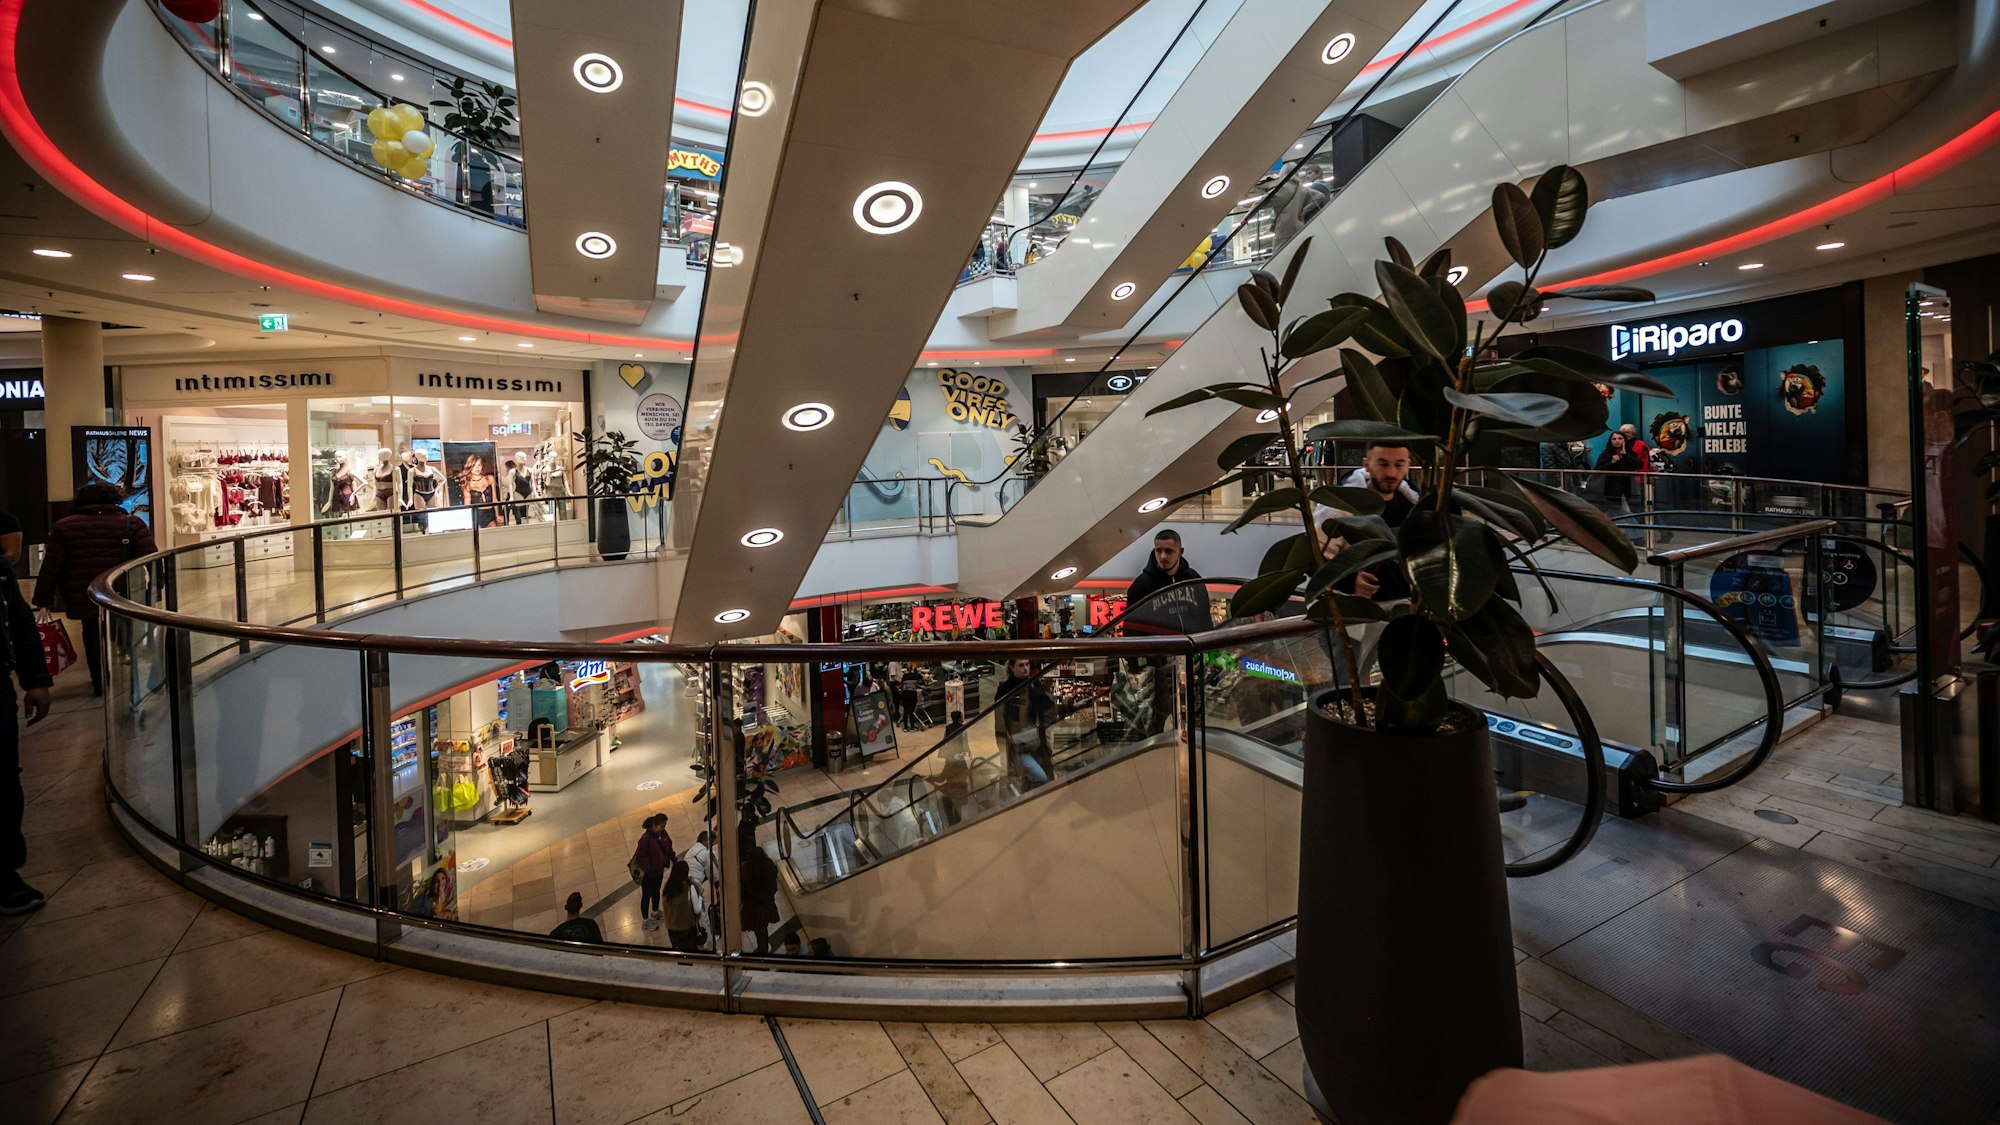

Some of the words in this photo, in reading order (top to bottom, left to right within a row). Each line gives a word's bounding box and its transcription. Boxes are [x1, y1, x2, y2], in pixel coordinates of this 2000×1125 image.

[1632, 318, 1743, 356] iRiparo
[175, 373, 331, 391] intimissimi
[419, 372, 562, 393] intimissimi
[936, 368, 1006, 395] GOOD
[940, 385, 1009, 412] VIBES
[1704, 404, 1742, 420] BUNTE
[946, 401, 1017, 429] ONLY
[912, 601, 1003, 633] REWE
[578, 660, 605, 679] dm
